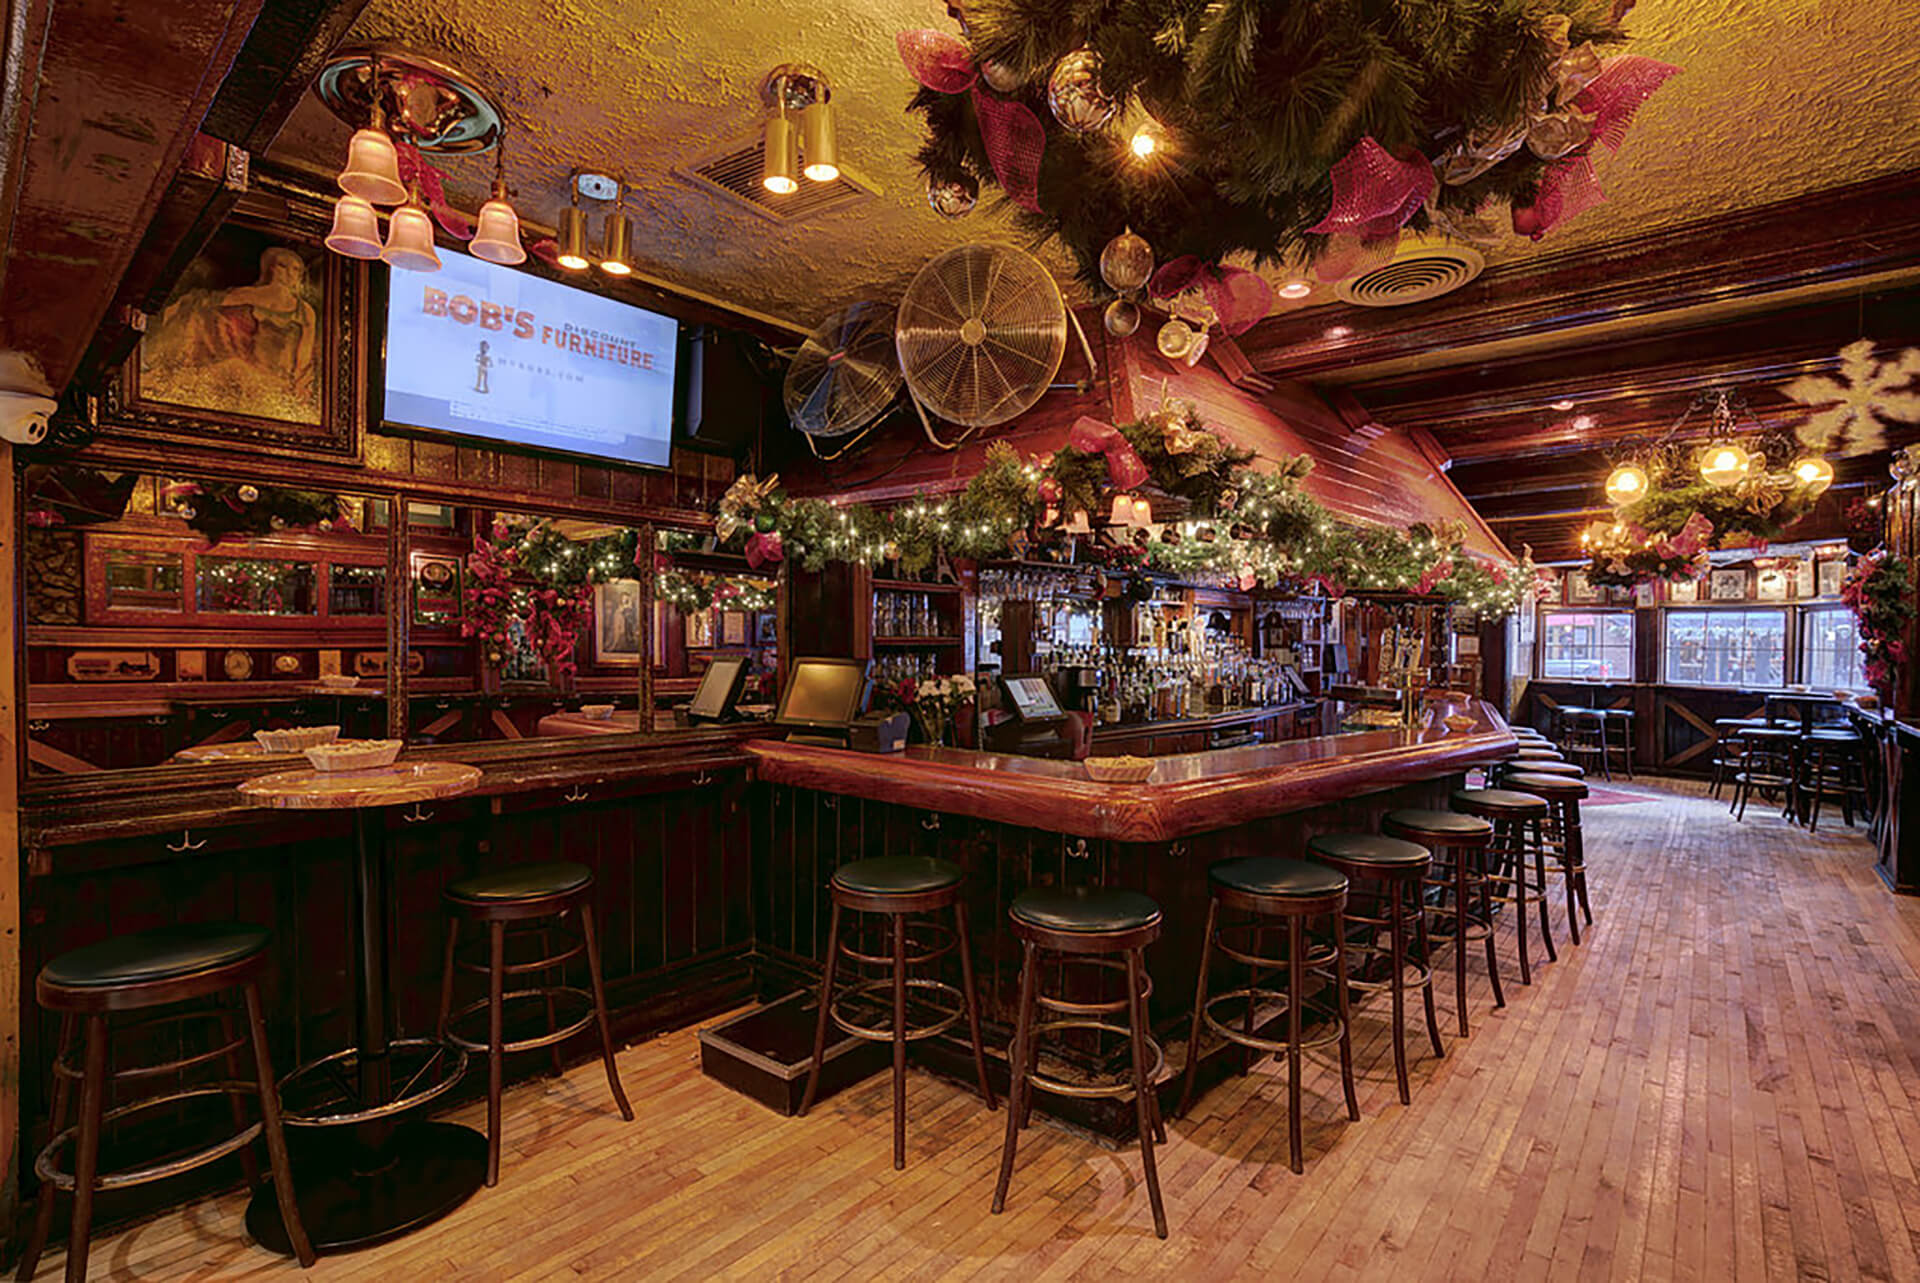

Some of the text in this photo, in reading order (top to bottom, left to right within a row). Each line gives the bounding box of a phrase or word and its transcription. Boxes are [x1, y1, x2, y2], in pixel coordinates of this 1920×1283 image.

[423, 285, 535, 339] BOB'S
[541, 326, 655, 370] FURNITURE
[564, 322, 637, 348] DISCOUNT
